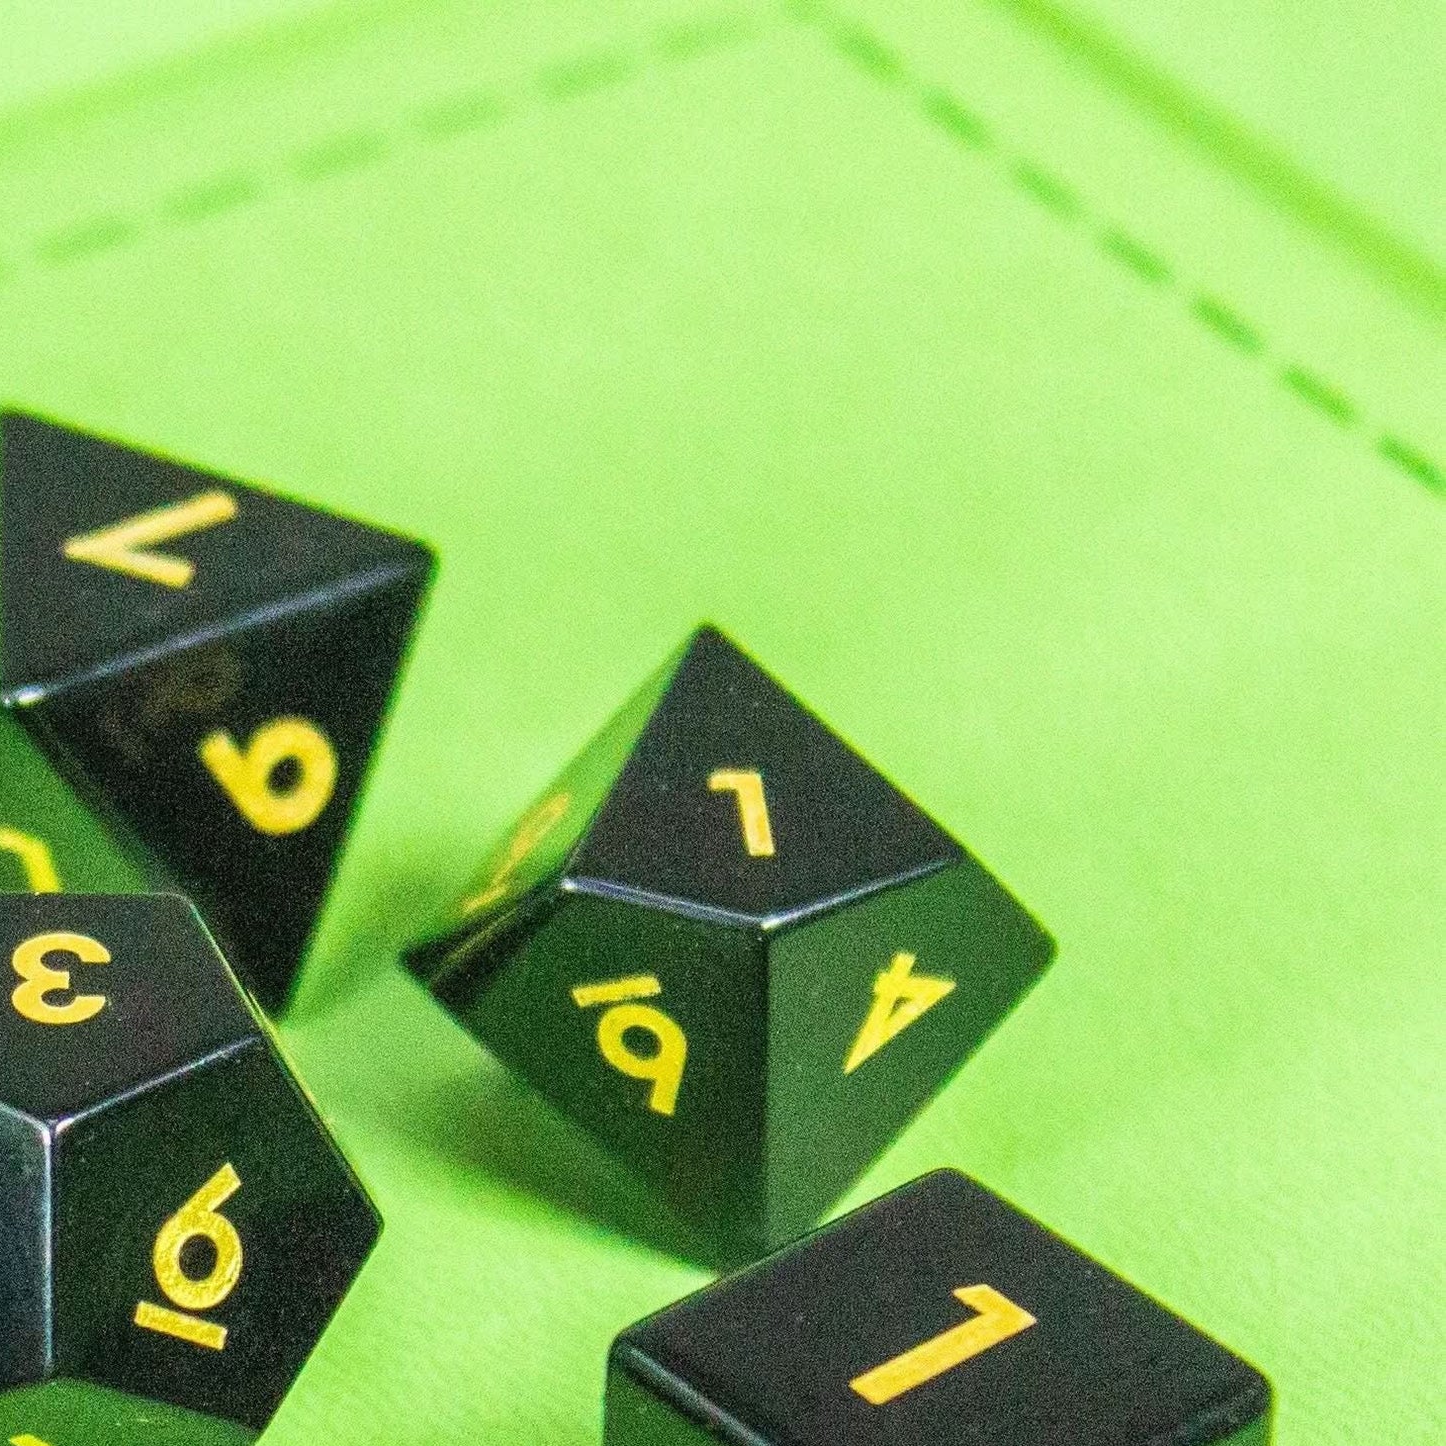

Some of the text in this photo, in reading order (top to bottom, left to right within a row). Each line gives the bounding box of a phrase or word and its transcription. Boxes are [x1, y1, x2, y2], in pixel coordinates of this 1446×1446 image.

[10, 932, 112, 1026] 3
[843, 951, 956, 1075] 4
[848, 1283, 1035, 1406] 1
